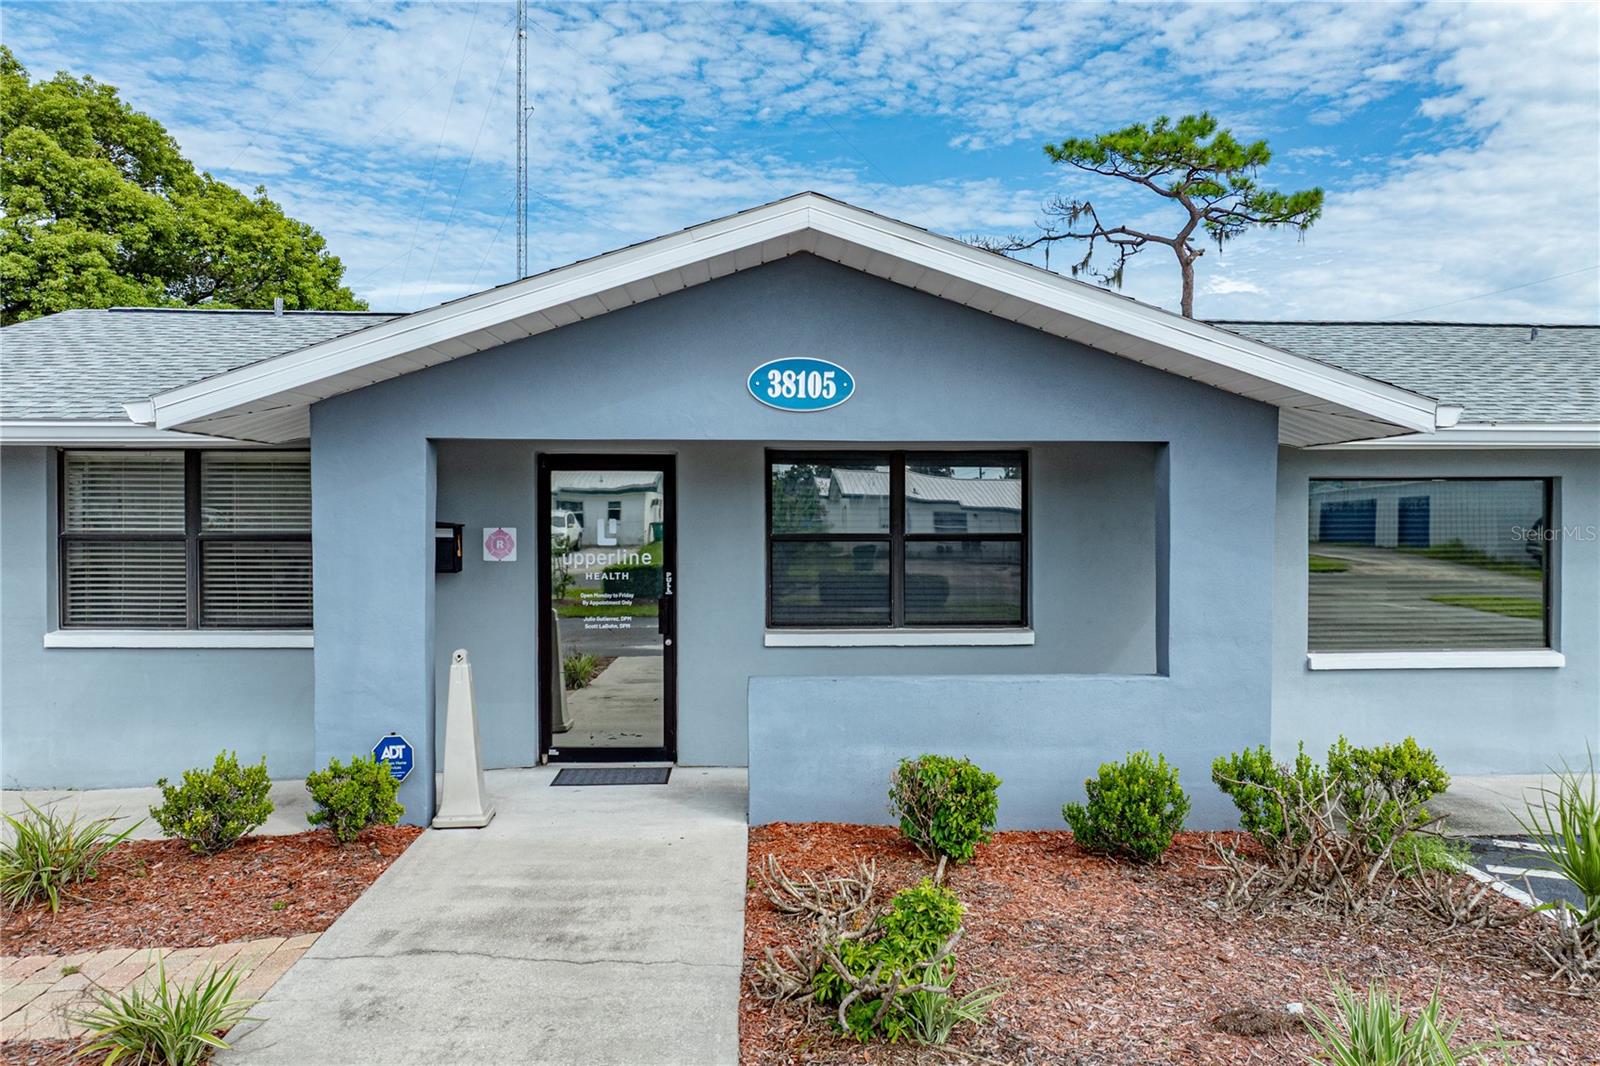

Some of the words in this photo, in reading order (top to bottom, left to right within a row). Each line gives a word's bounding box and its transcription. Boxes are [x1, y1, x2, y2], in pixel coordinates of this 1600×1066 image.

[767, 369, 837, 399] 38105
[496, 540, 504, 549] R
[562, 549, 652, 569] upperline
[585, 572, 629, 580] HEALTH
[380, 745, 406, 760] ADT
